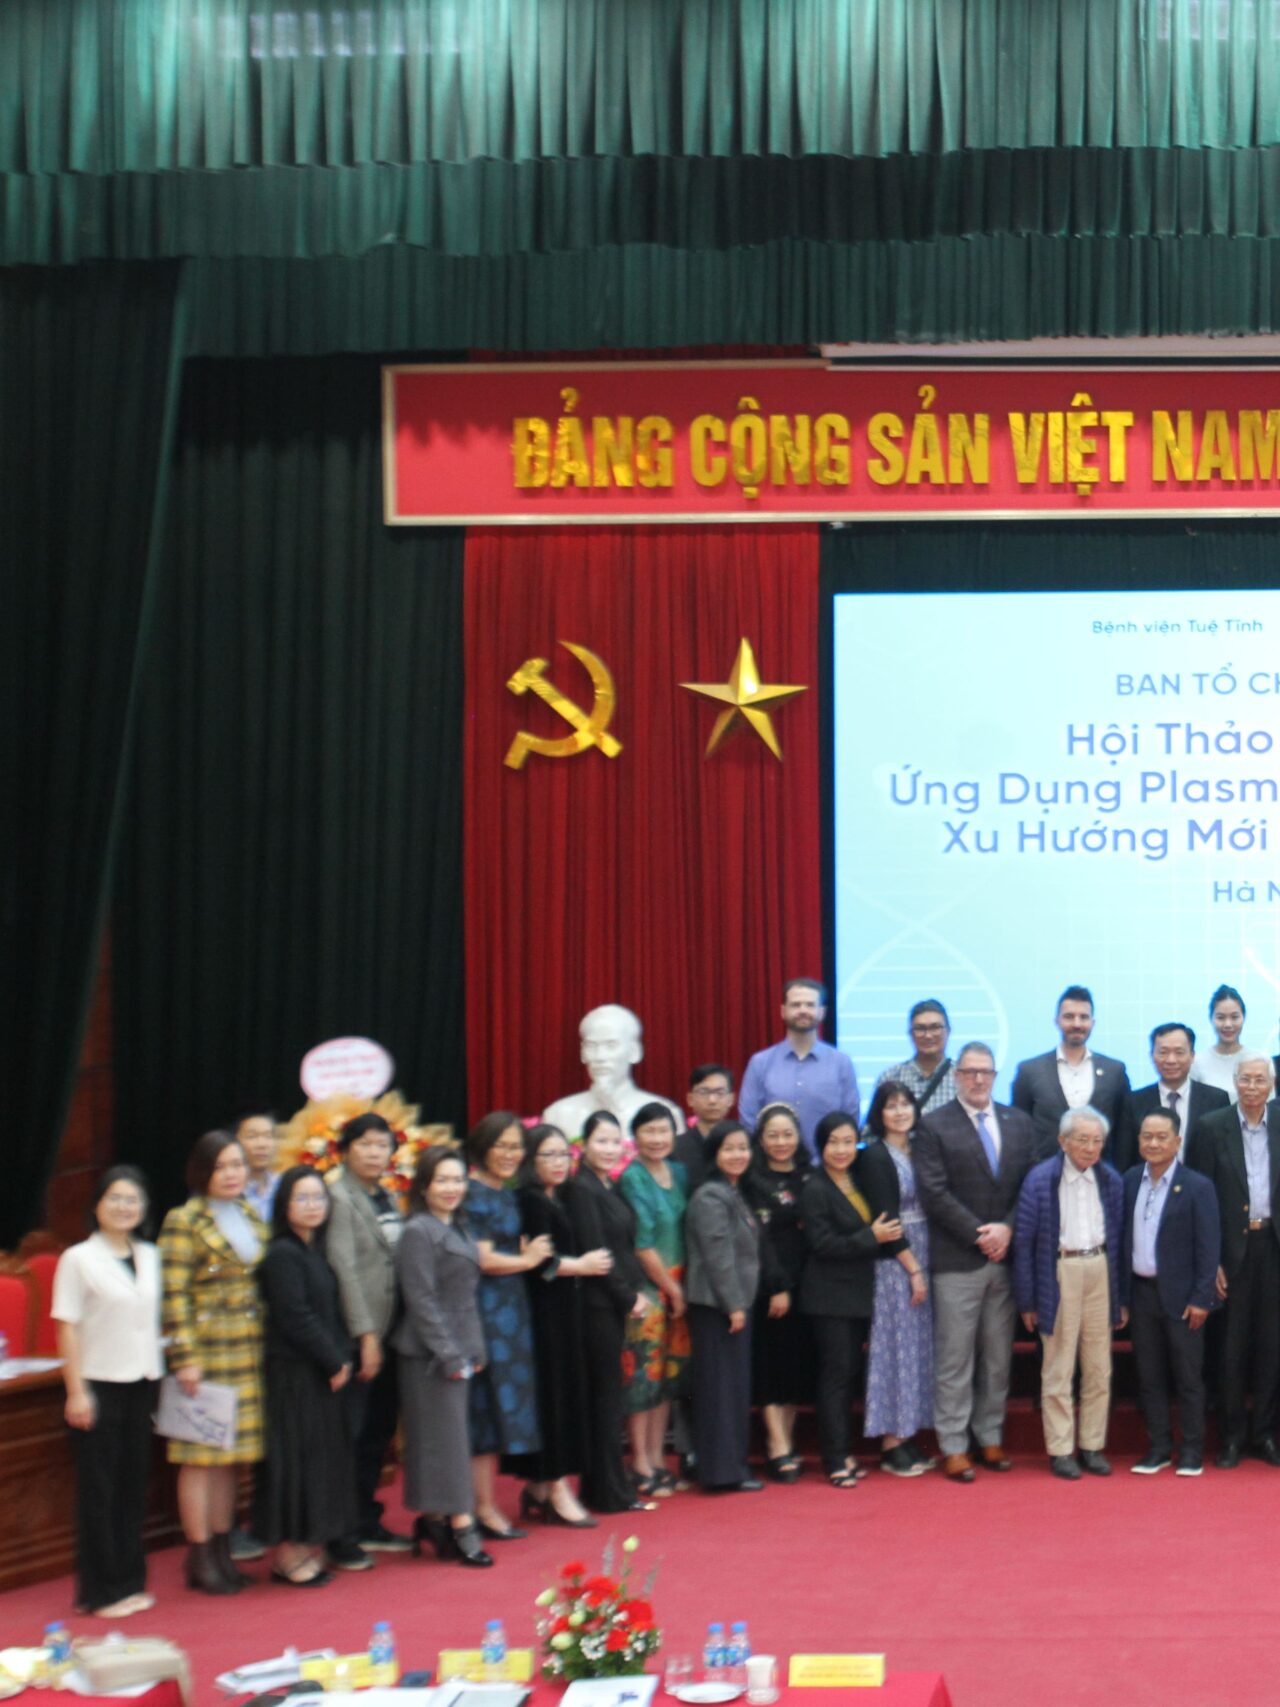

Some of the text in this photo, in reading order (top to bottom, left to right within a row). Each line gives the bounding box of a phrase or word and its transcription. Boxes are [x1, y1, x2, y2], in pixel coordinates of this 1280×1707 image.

[512, 387, 674, 489] ĐẢNG
[690, 396, 851, 498] CỘNG
[867, 384, 991, 486] SẢN
[1008, 392, 1135, 496] VIỆT
[1092, 620, 1138, 637] Bệnh
[1144, 620, 1181, 637] viện
[1187, 619, 1219, 637] Tuệ
[1116, 672, 1181, 697] BAN
[1191, 662, 1238, 696] TỔ
[1066, 723, 1139, 766] Hội
[1155, 720, 1274, 755] Thảo
[889, 764, 981, 814] Ứng
[998, 771, 1121, 814] Dụng
[942, 820, 999, 854] Xu
[1017, 819, 1169, 861] Hướng
[1187, 818, 1268, 852] Mới
[1213, 880, 1256, 903] Hà
